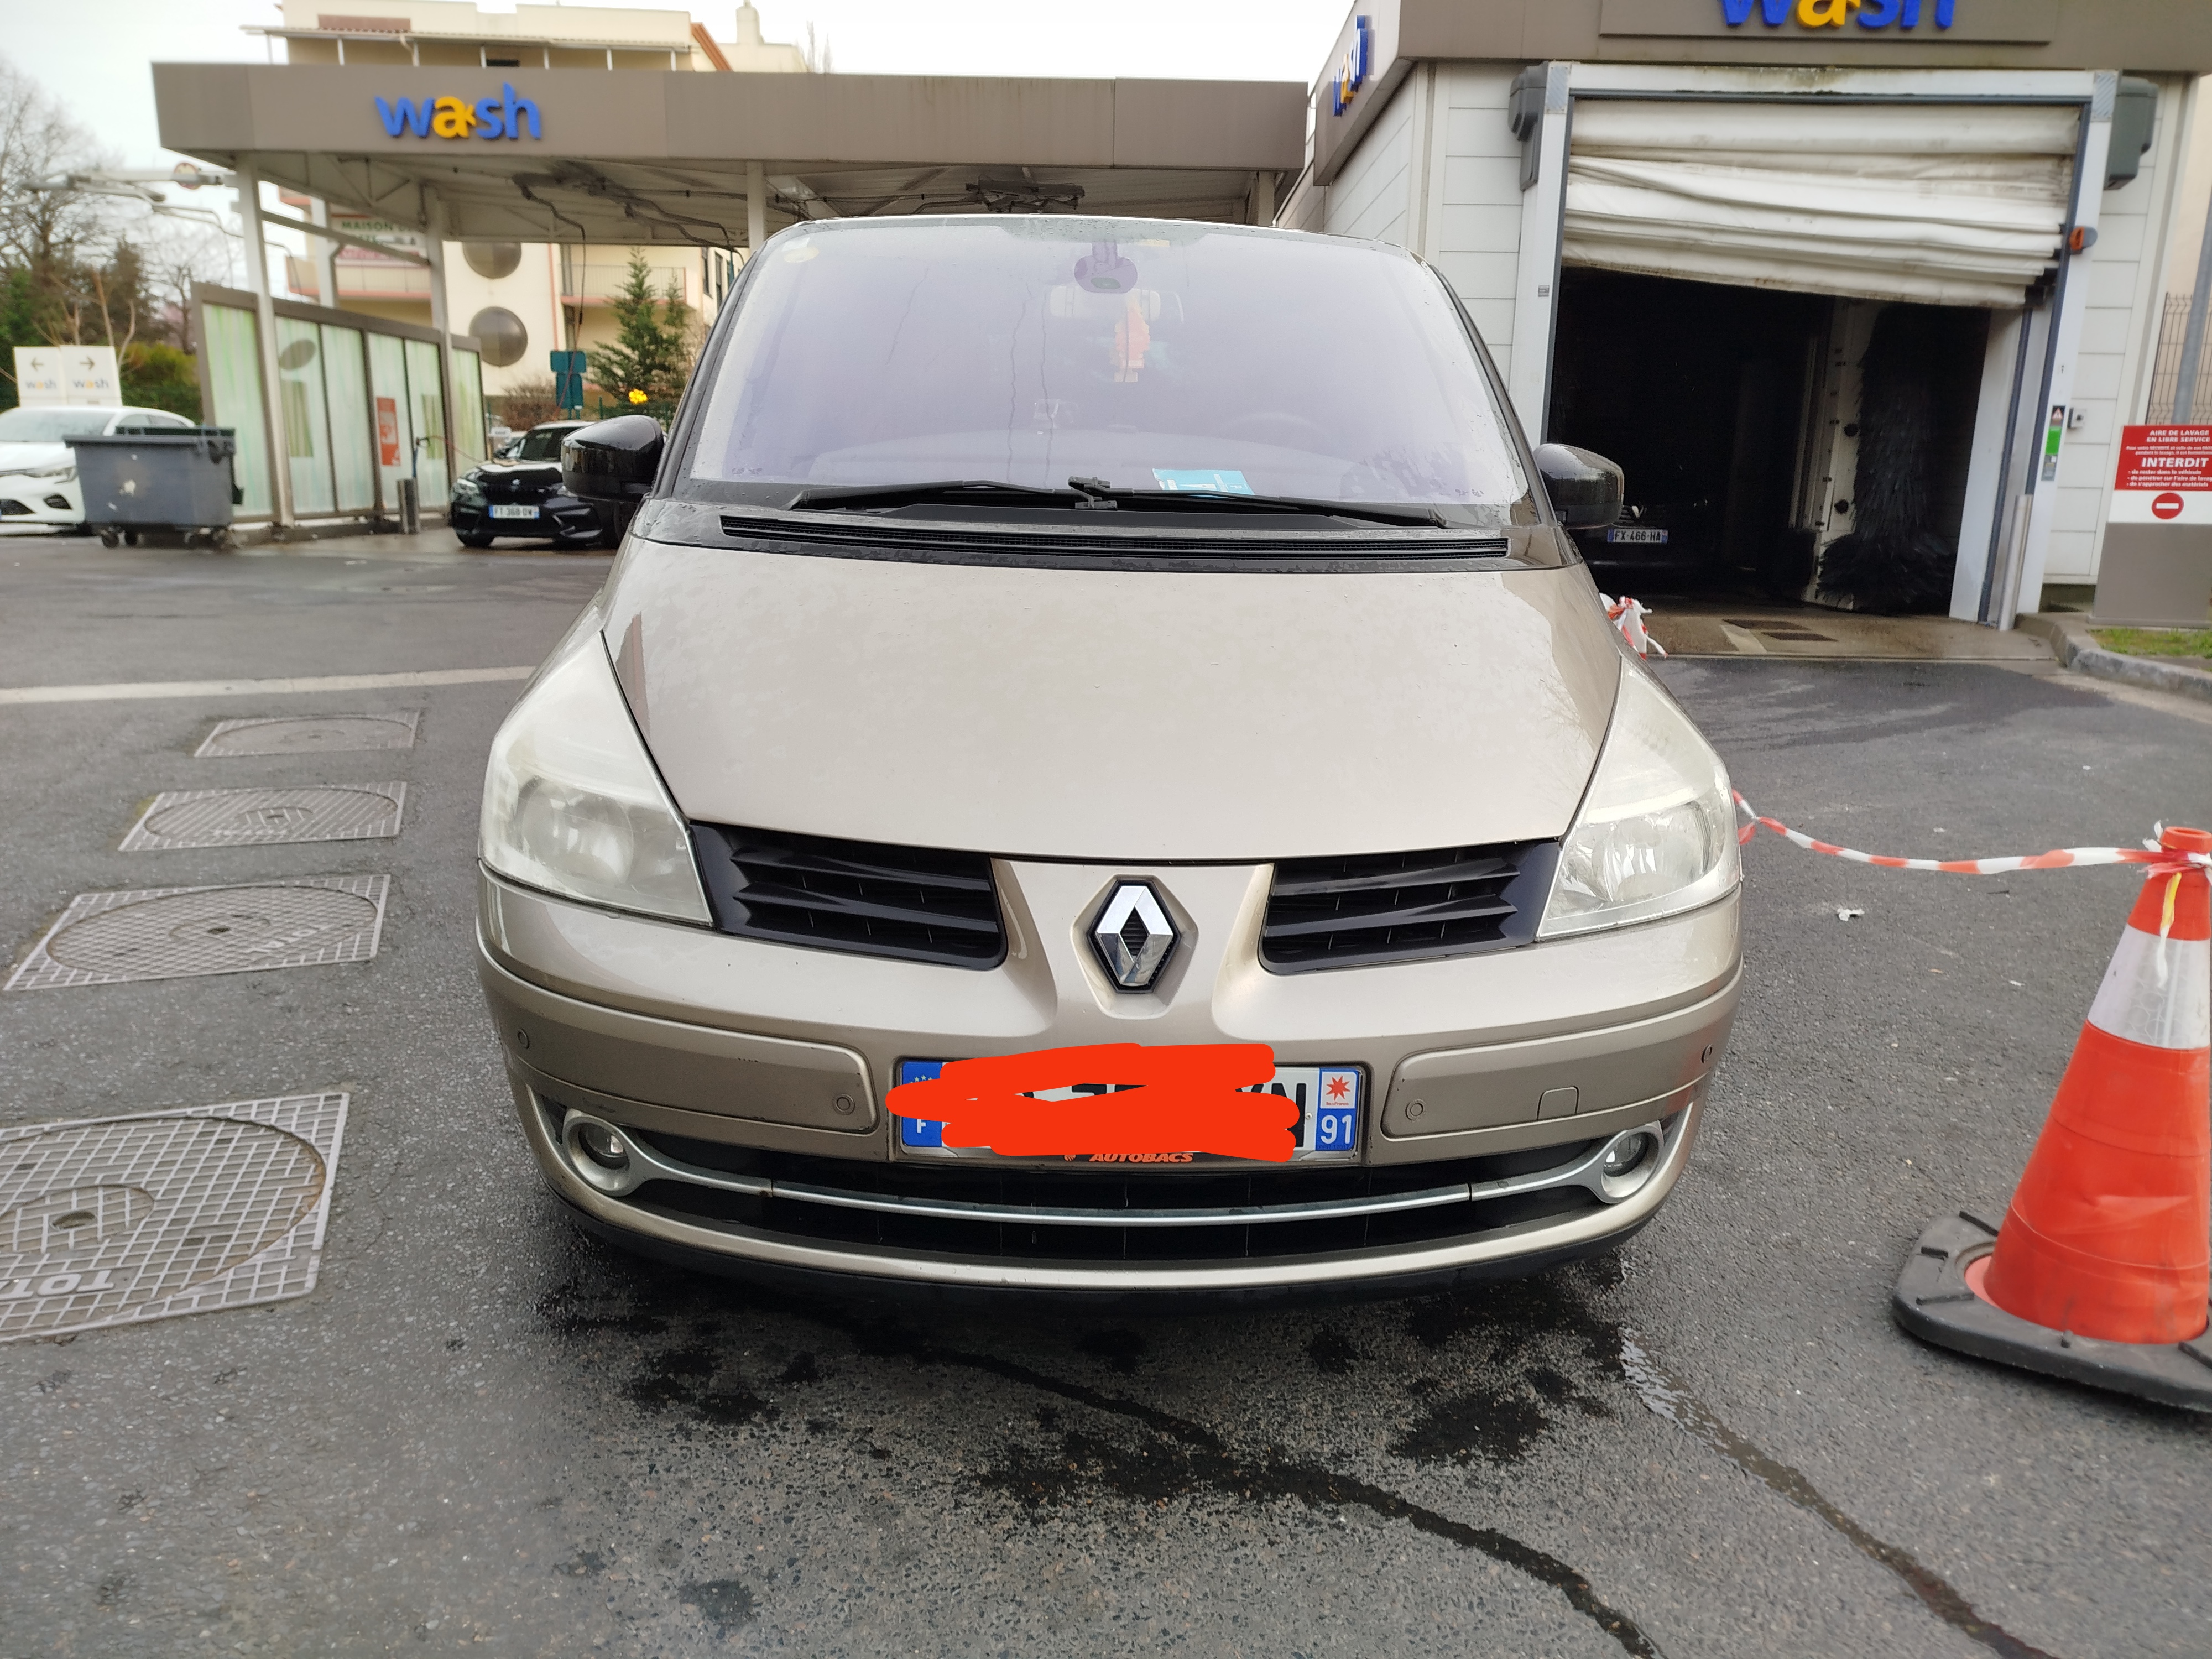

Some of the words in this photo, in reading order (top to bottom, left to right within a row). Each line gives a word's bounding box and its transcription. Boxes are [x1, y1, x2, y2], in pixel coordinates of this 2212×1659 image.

[374, 81, 542, 140] wash
[342, 221, 393, 231] MAISON
[25, 378, 56, 389] wash
[72, 377, 109, 389] wash
[2142, 457, 2209, 468] INTERDIT
[1321, 1114, 1352, 1144] 91
[1088, 1152, 1194, 1163] AUTOBACS
[0, 1270, 115, 1300] TOT
